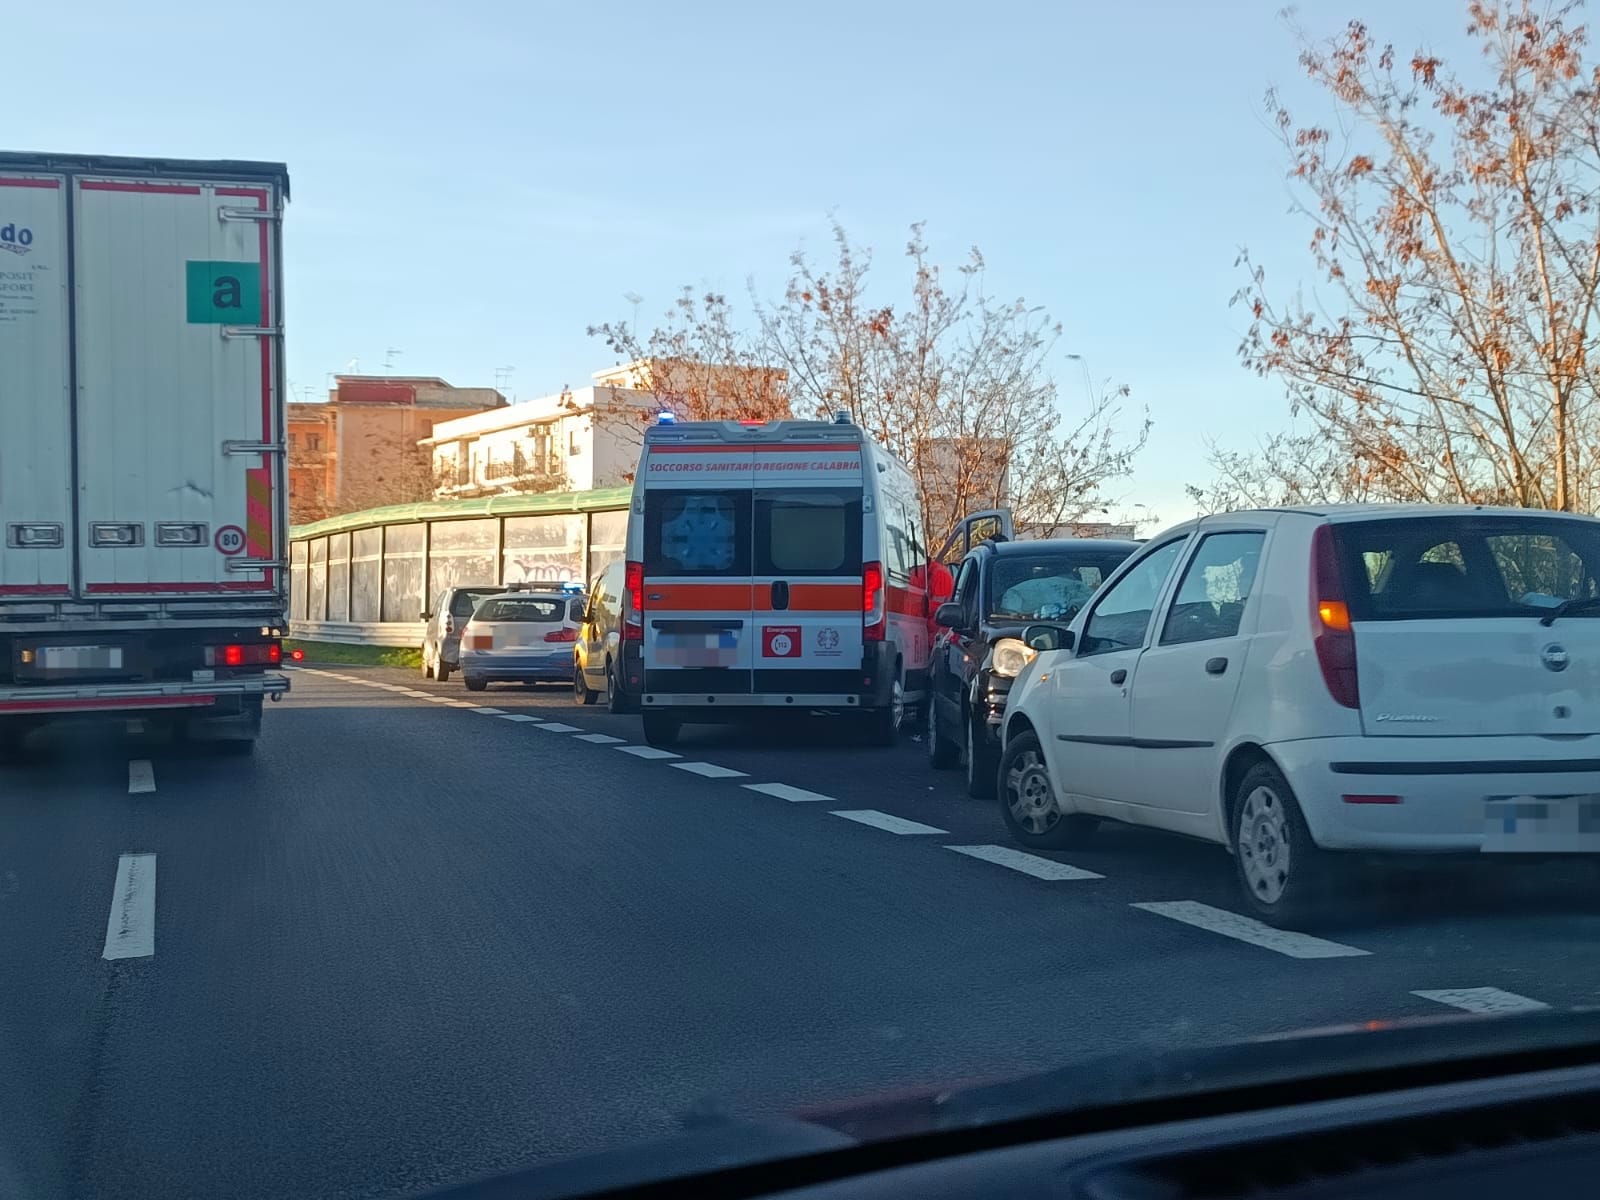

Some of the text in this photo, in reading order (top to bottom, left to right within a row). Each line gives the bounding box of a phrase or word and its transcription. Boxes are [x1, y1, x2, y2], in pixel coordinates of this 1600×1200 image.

[212, 275, 242, 309] a
[649, 461, 860, 472] SOCCORSO SANITARIO REGIONE CALABRIA
[223, 534, 239, 546] 80
